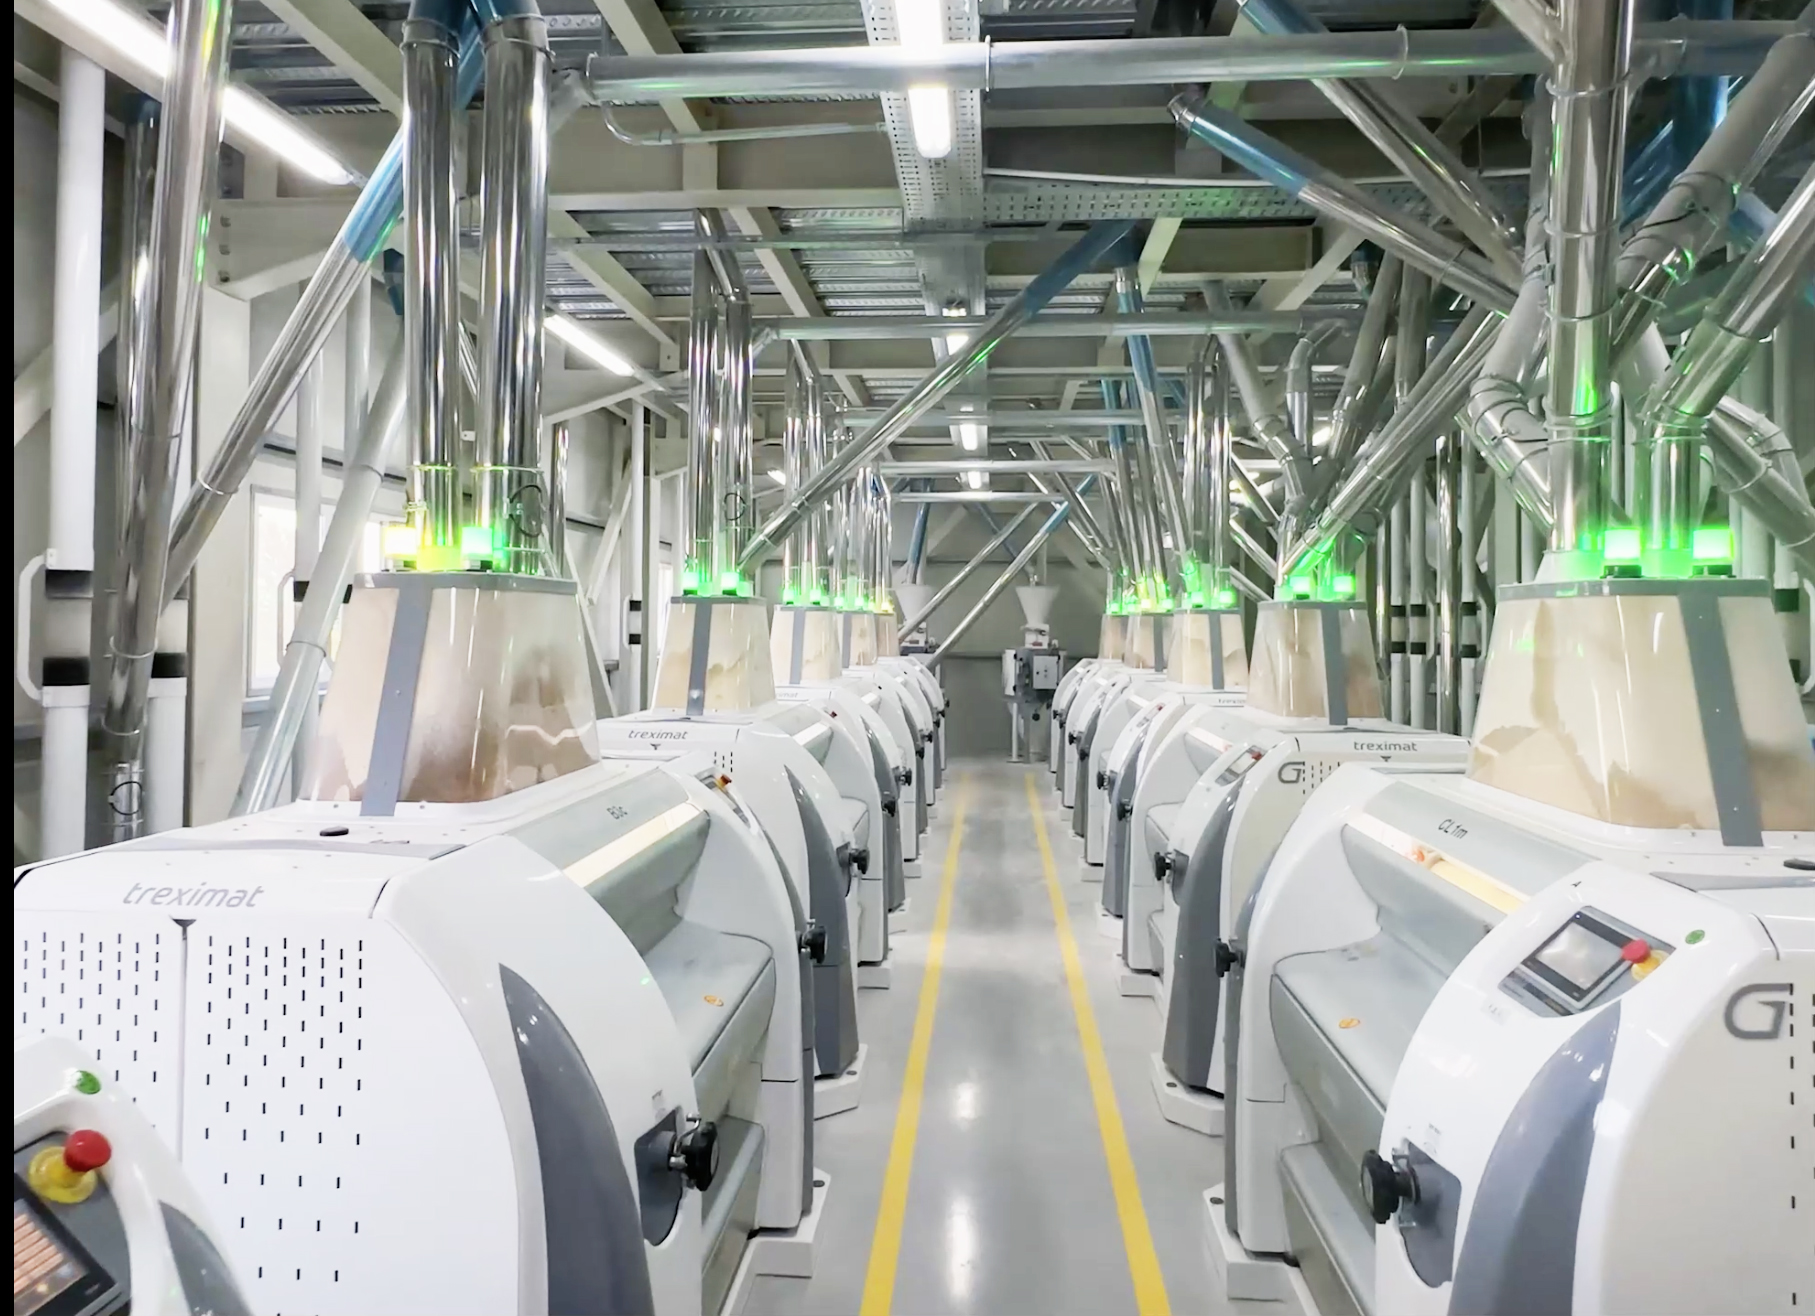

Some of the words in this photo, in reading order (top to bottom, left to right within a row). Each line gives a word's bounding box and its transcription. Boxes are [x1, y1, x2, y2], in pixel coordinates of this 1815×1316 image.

[628, 730, 688, 740] treximat
[1353, 741, 1418, 752] treximat
[1277, 761, 1303, 784] G
[122, 881, 265, 908] treximat
[1724, 983, 1791, 1040] G
